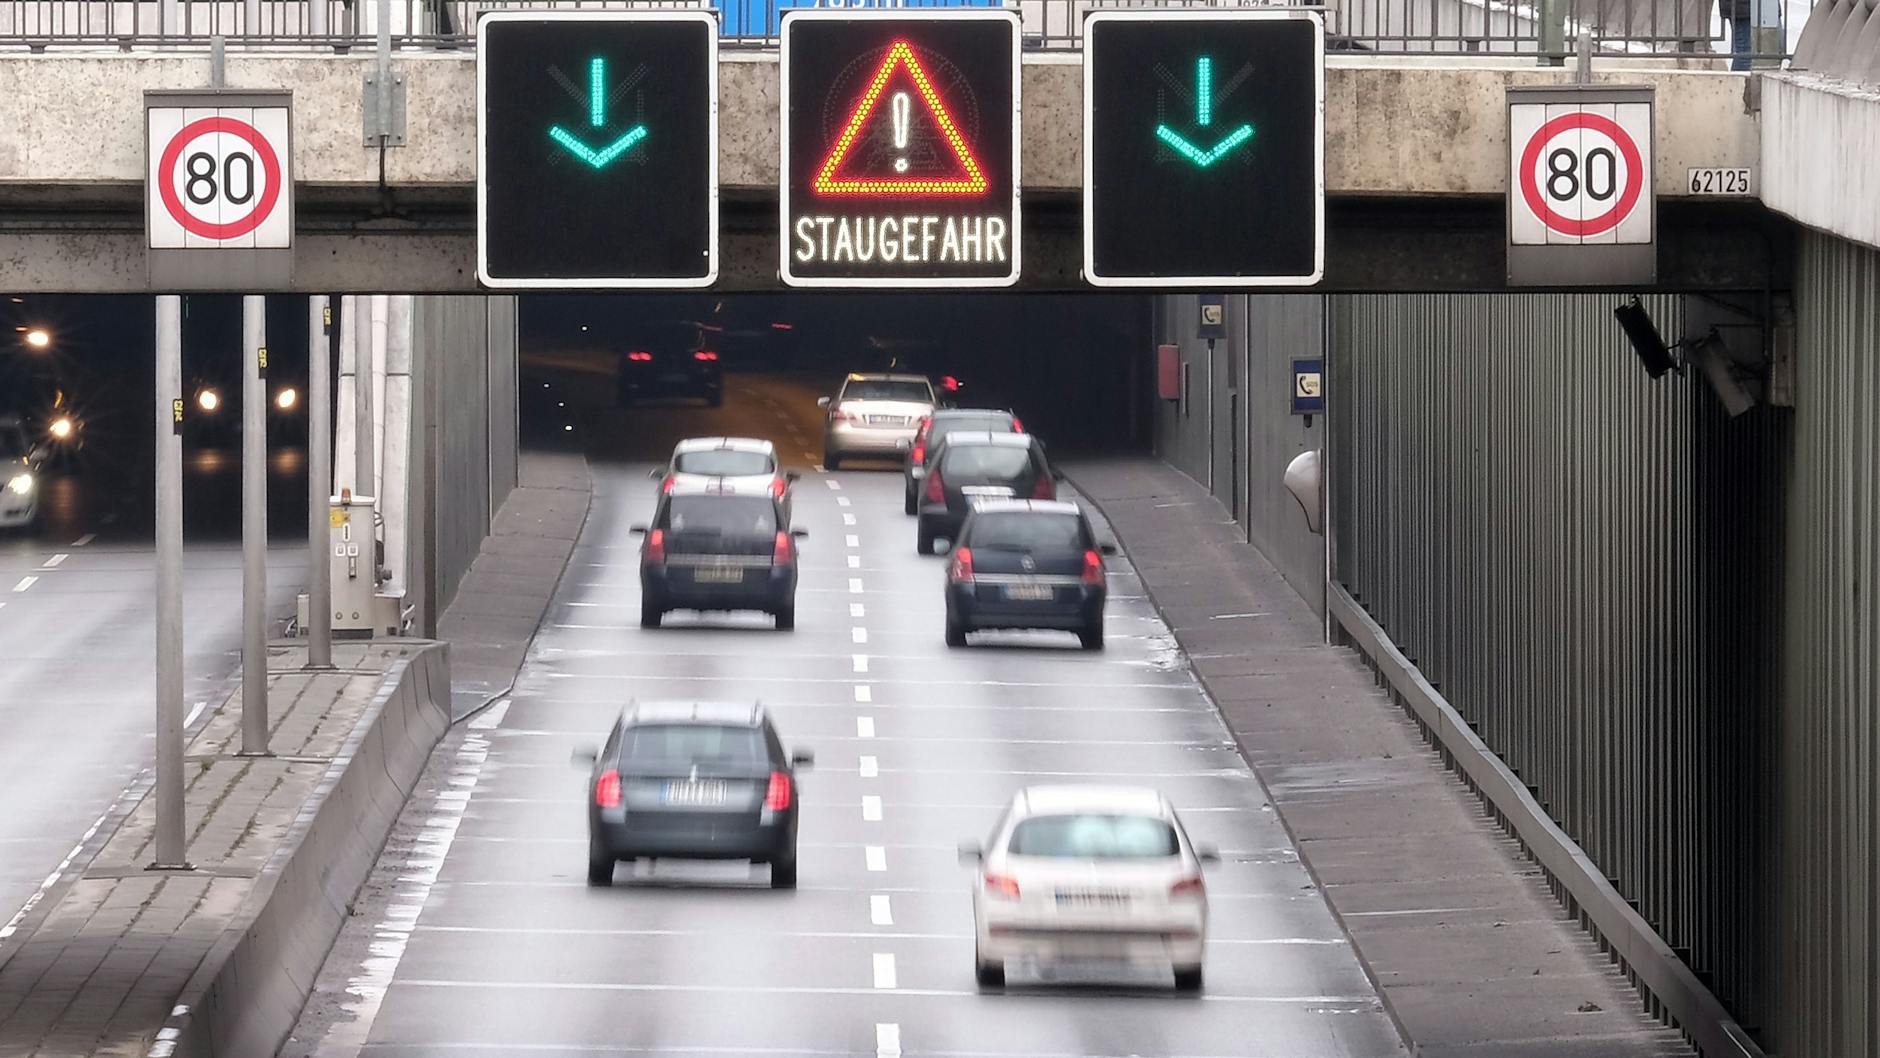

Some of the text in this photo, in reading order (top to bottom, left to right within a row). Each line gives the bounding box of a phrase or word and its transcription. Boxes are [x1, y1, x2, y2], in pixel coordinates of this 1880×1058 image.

[186, 151, 254, 205] 80
[1547, 147, 1616, 202] 80
[1691, 170, 1748, 193] 62125
[795, 216, 1005, 262] STAUGEFAHR
